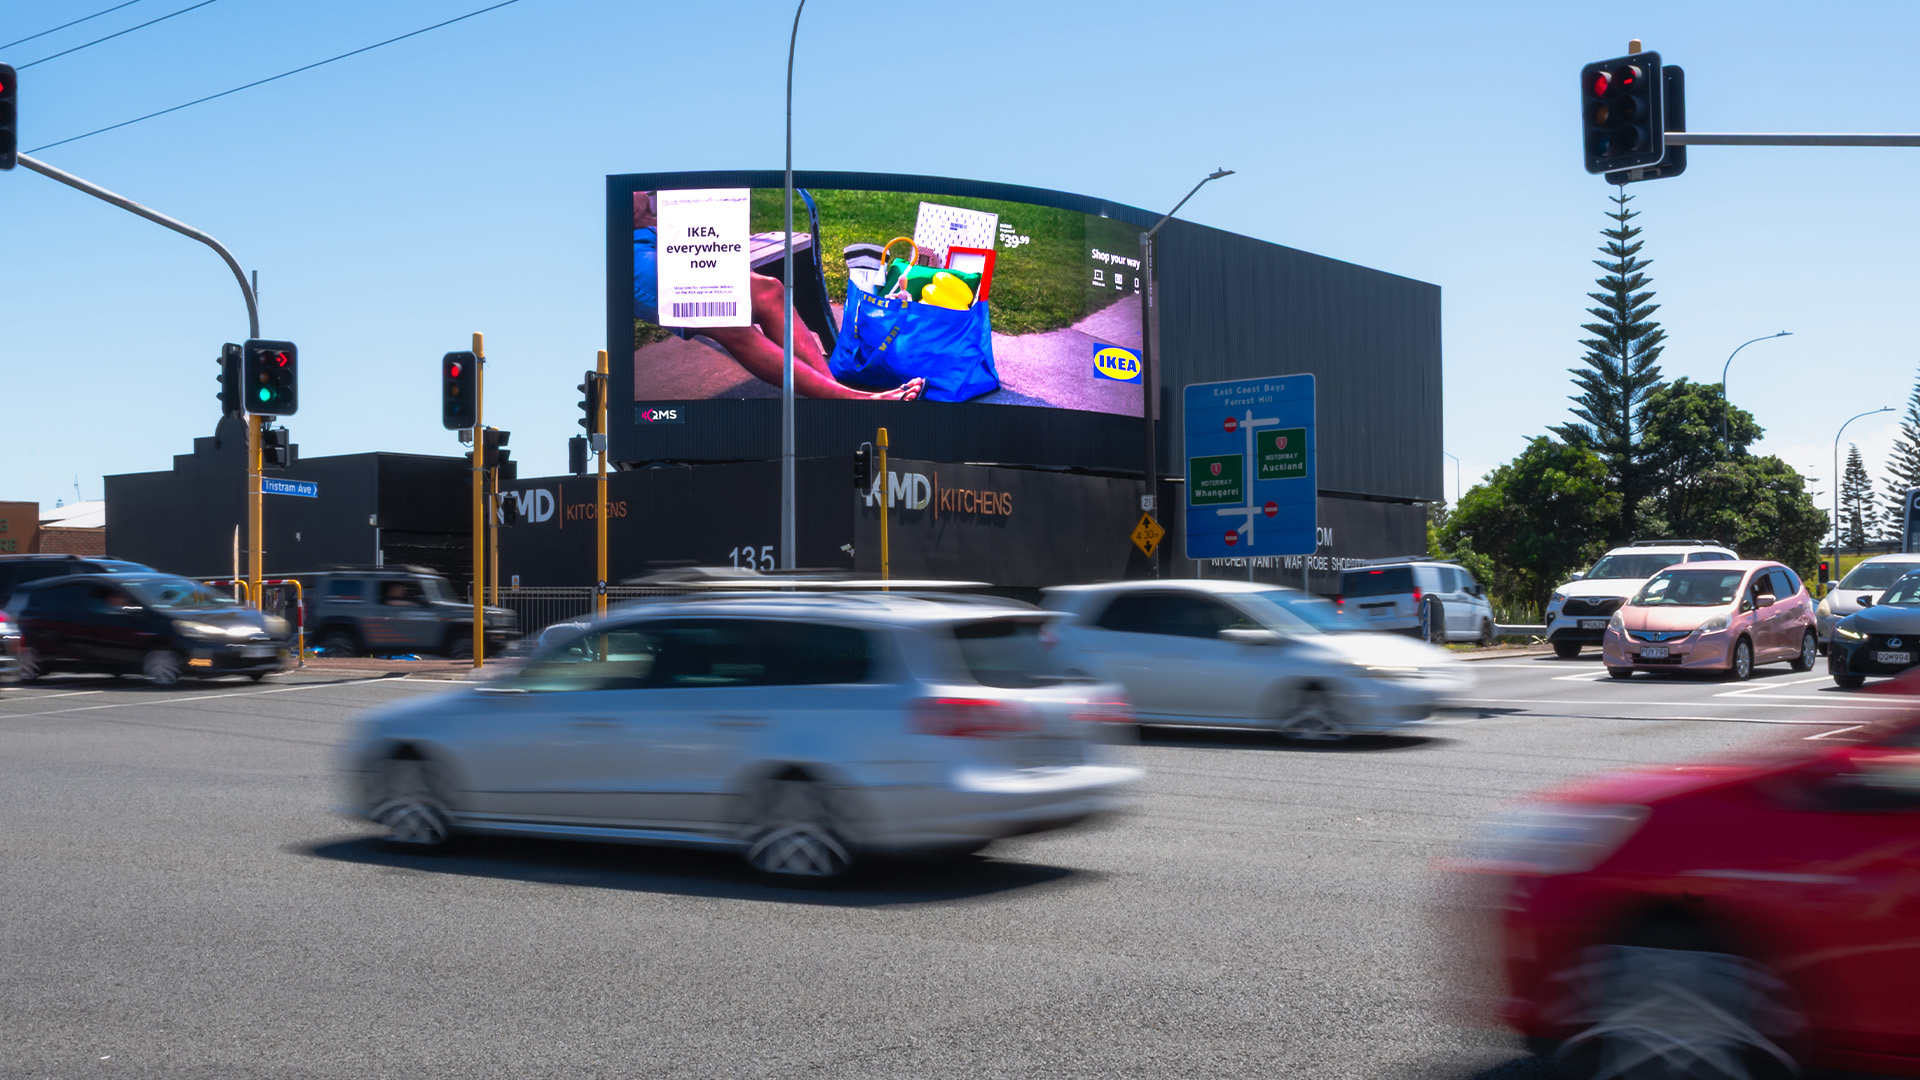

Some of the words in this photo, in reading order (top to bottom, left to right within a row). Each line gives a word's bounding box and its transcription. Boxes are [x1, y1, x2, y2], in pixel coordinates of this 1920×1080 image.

[687, 226, 720, 239] IKEA,
[666, 241, 742, 256] everywhere
[690, 259, 717, 269] now
[1091, 248, 1110, 264] Shop
[1110, 254, 1126, 265] your
[1126, 257, 1141, 271] way
[1099, 354, 1138, 373] IKEA
[1214, 388, 1233, 396] East
[1236, 386, 1260, 394] Coast
[1264, 384, 1285, 392] Bays
[1225, 397, 1254, 406] Forrest
[645, 408, 678, 422] QMS
[1262, 462, 1303, 472] Auckland
[264, 480, 296, 492] Tristram
[297, 483, 312, 494] Ave
[1195, 488, 1239, 498] Whangarei
[941, 488, 1012, 516] KITCHENS
[1143, 498, 1151, 507] 21
[729, 545, 775, 572] 135
